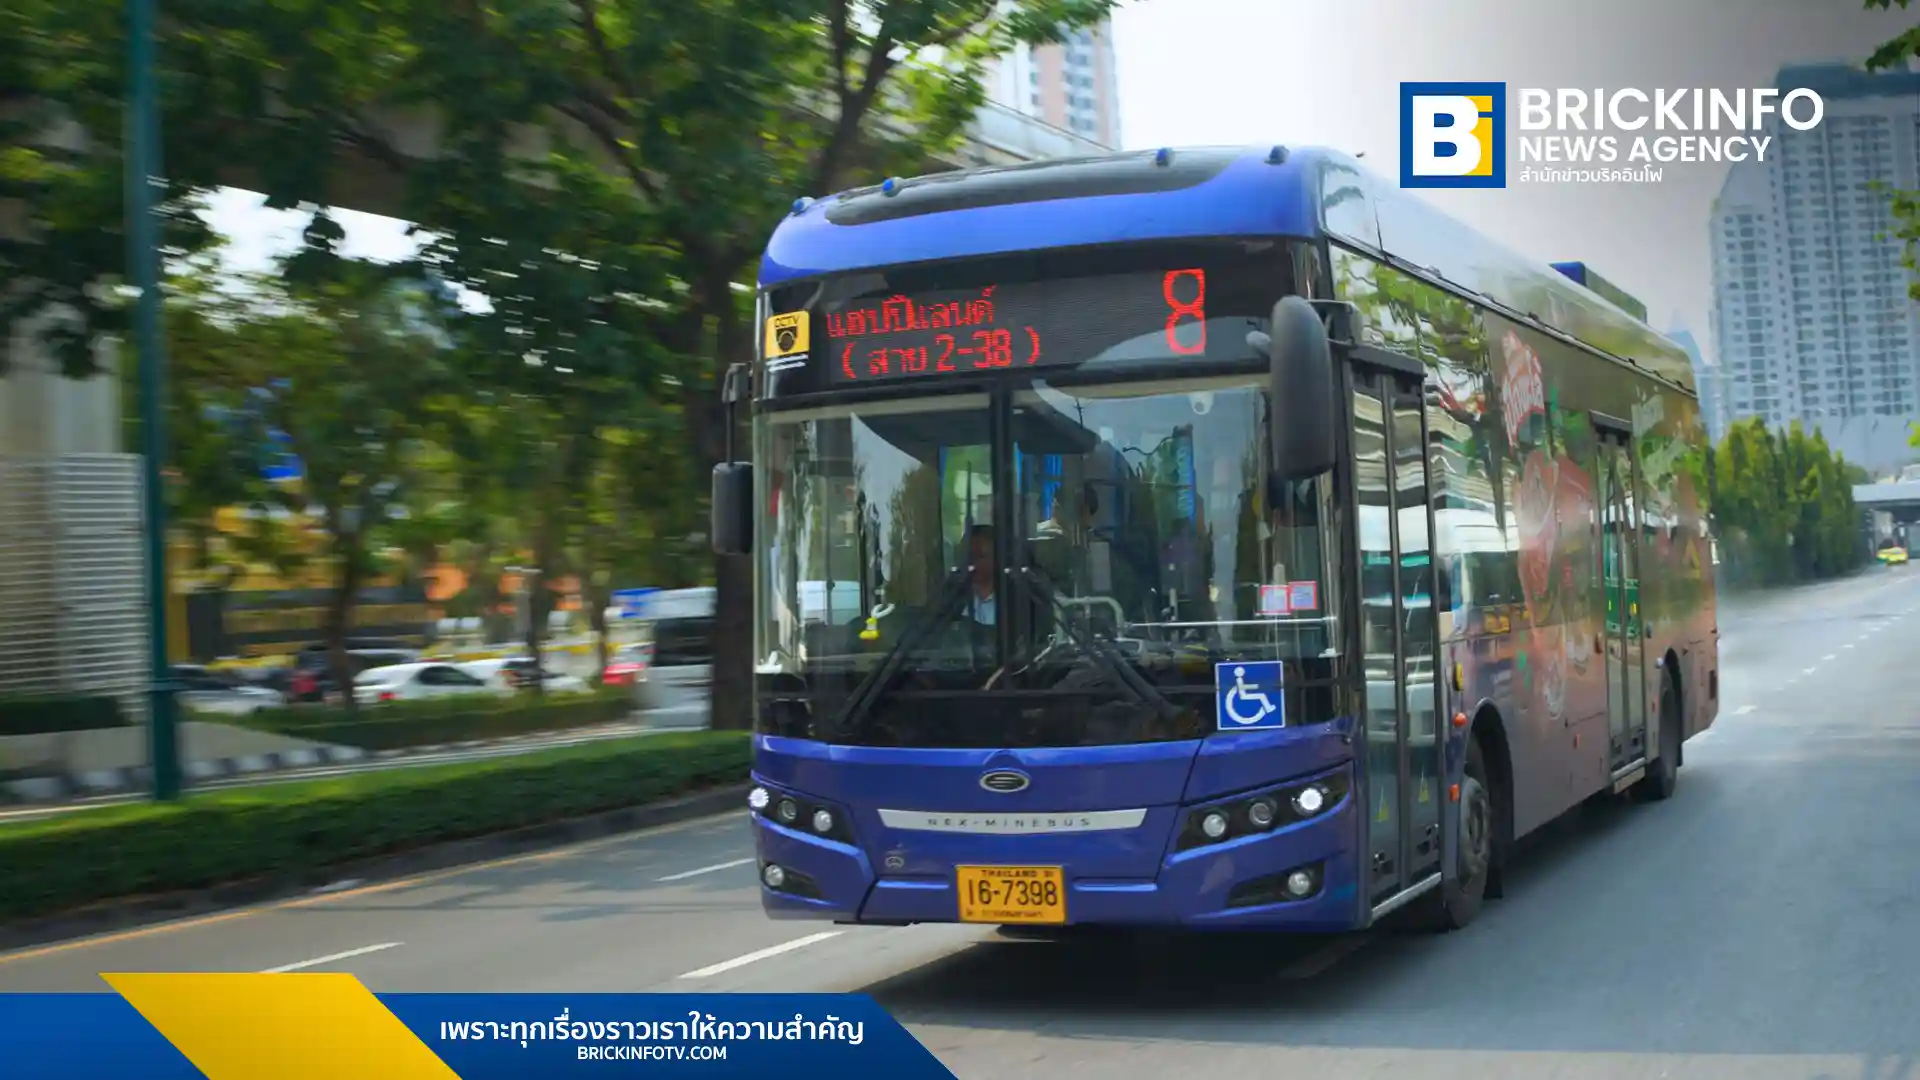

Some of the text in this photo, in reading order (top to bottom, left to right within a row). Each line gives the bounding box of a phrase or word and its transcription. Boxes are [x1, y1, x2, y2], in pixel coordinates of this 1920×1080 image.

[1163, 268, 1206, 354] 8
[867, 347, 928, 375] สาย
[935, 328, 1012, 372] 2-38
[968, 879, 1058, 906] 16-7398
